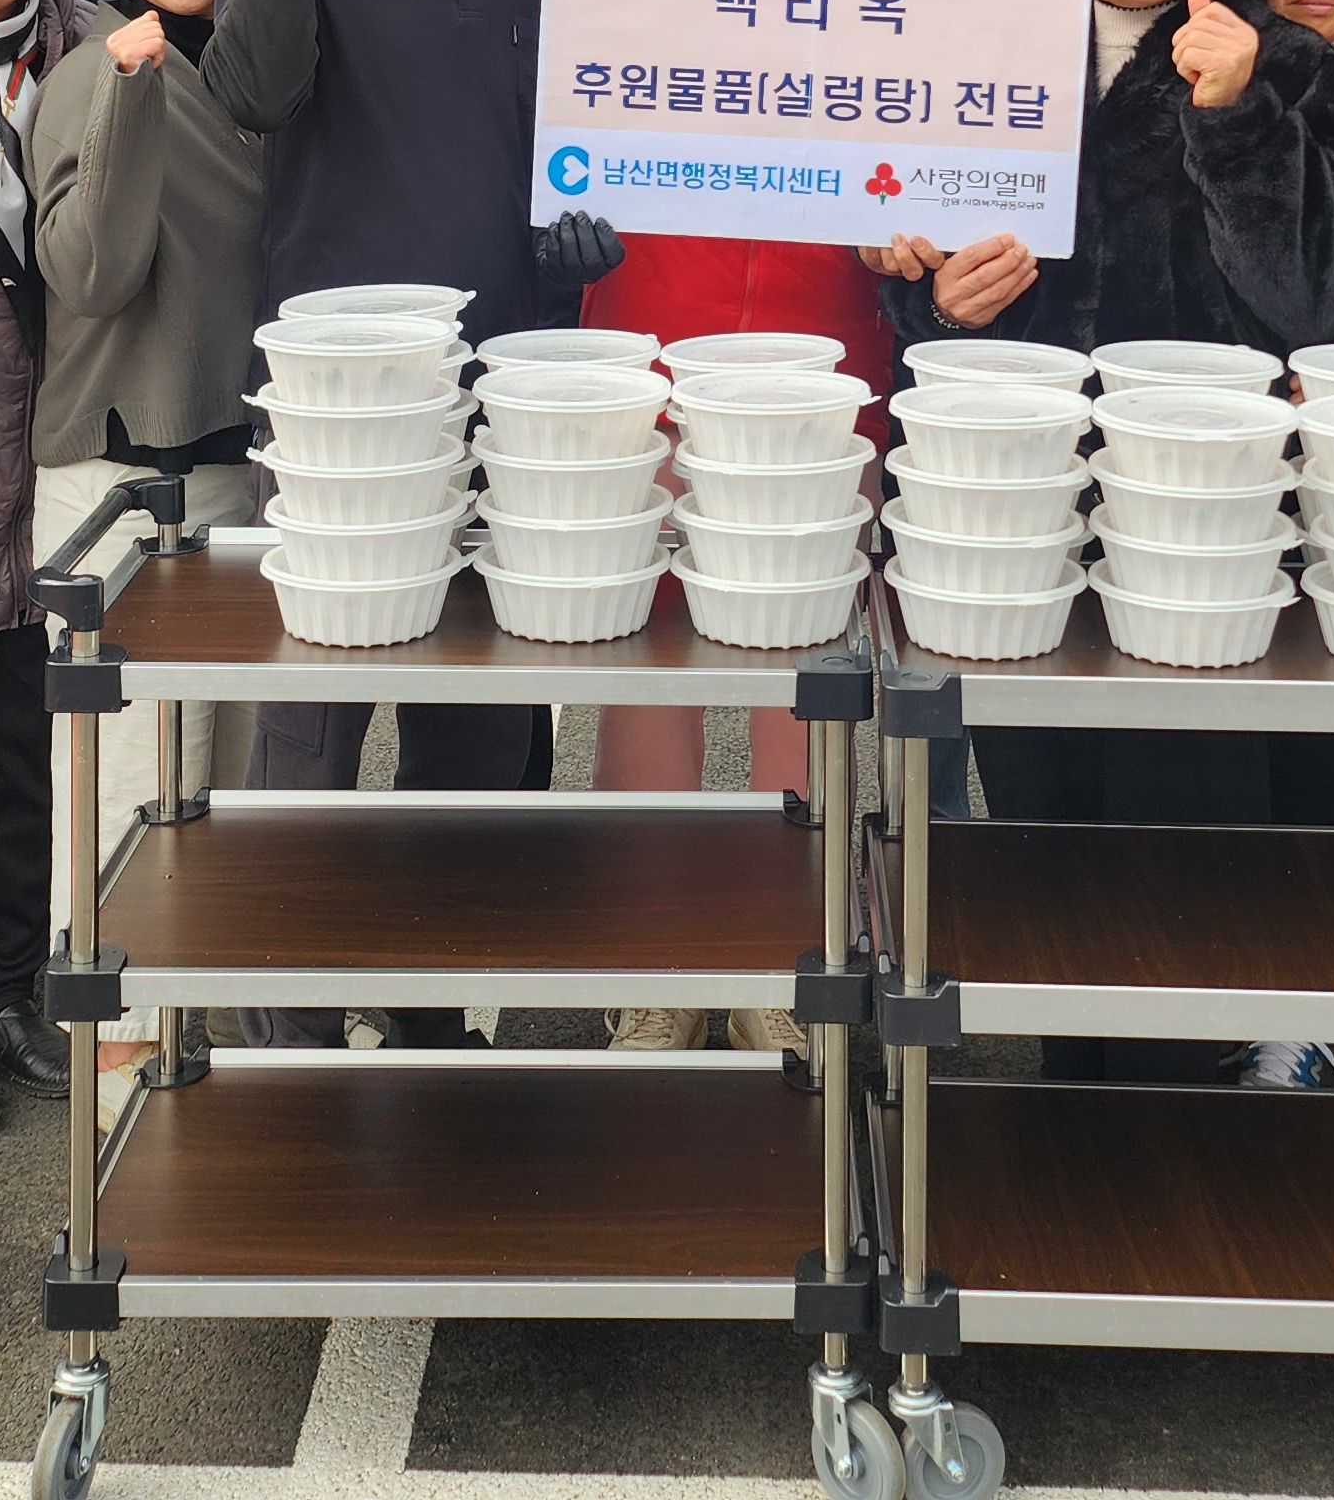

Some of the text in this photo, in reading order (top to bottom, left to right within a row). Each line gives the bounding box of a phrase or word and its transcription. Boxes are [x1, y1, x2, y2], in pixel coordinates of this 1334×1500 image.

[953, 78, 1051, 131] 전달
[602, 156, 842, 198] 남산면행정복지센터
[909, 167, 1047, 198] 사랑의열매
